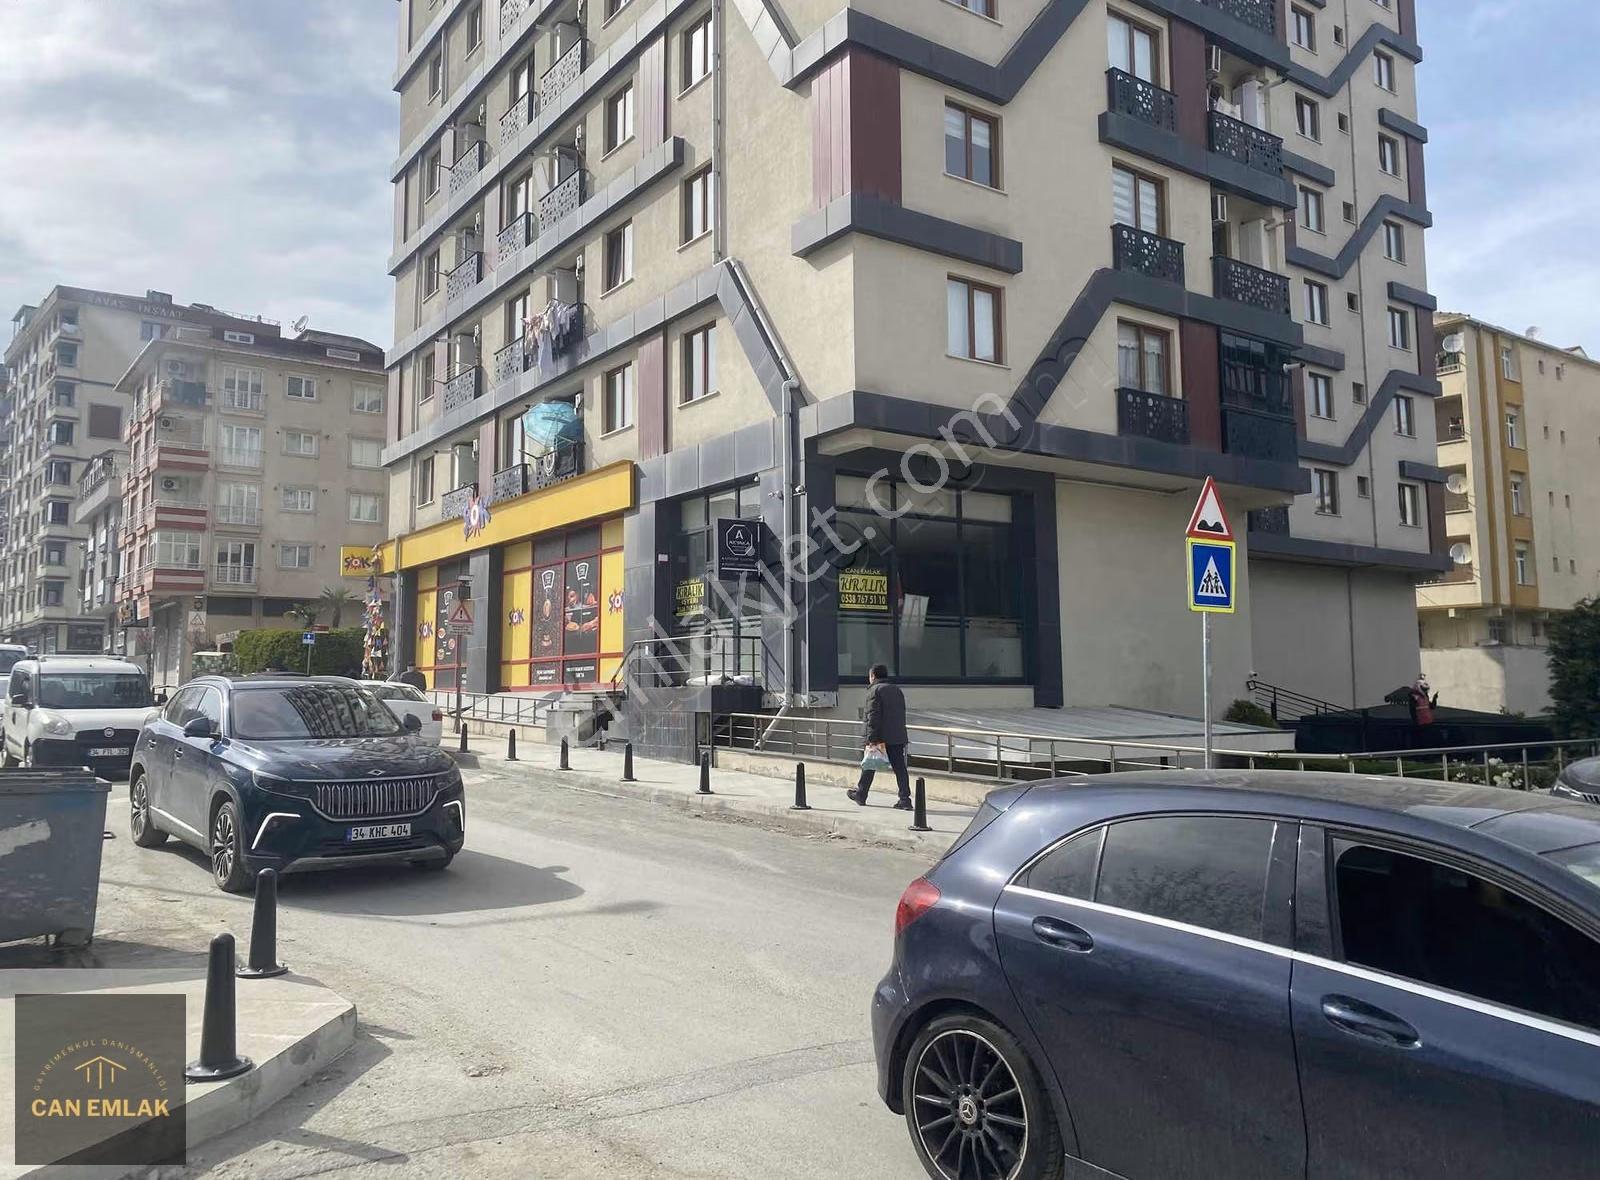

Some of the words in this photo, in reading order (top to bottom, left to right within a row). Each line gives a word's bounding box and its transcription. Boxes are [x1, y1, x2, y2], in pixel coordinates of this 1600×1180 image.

[352, 828, 365, 839] 34
[369, 826, 387, 838] KHC
[391, 825, 408, 836] 404
